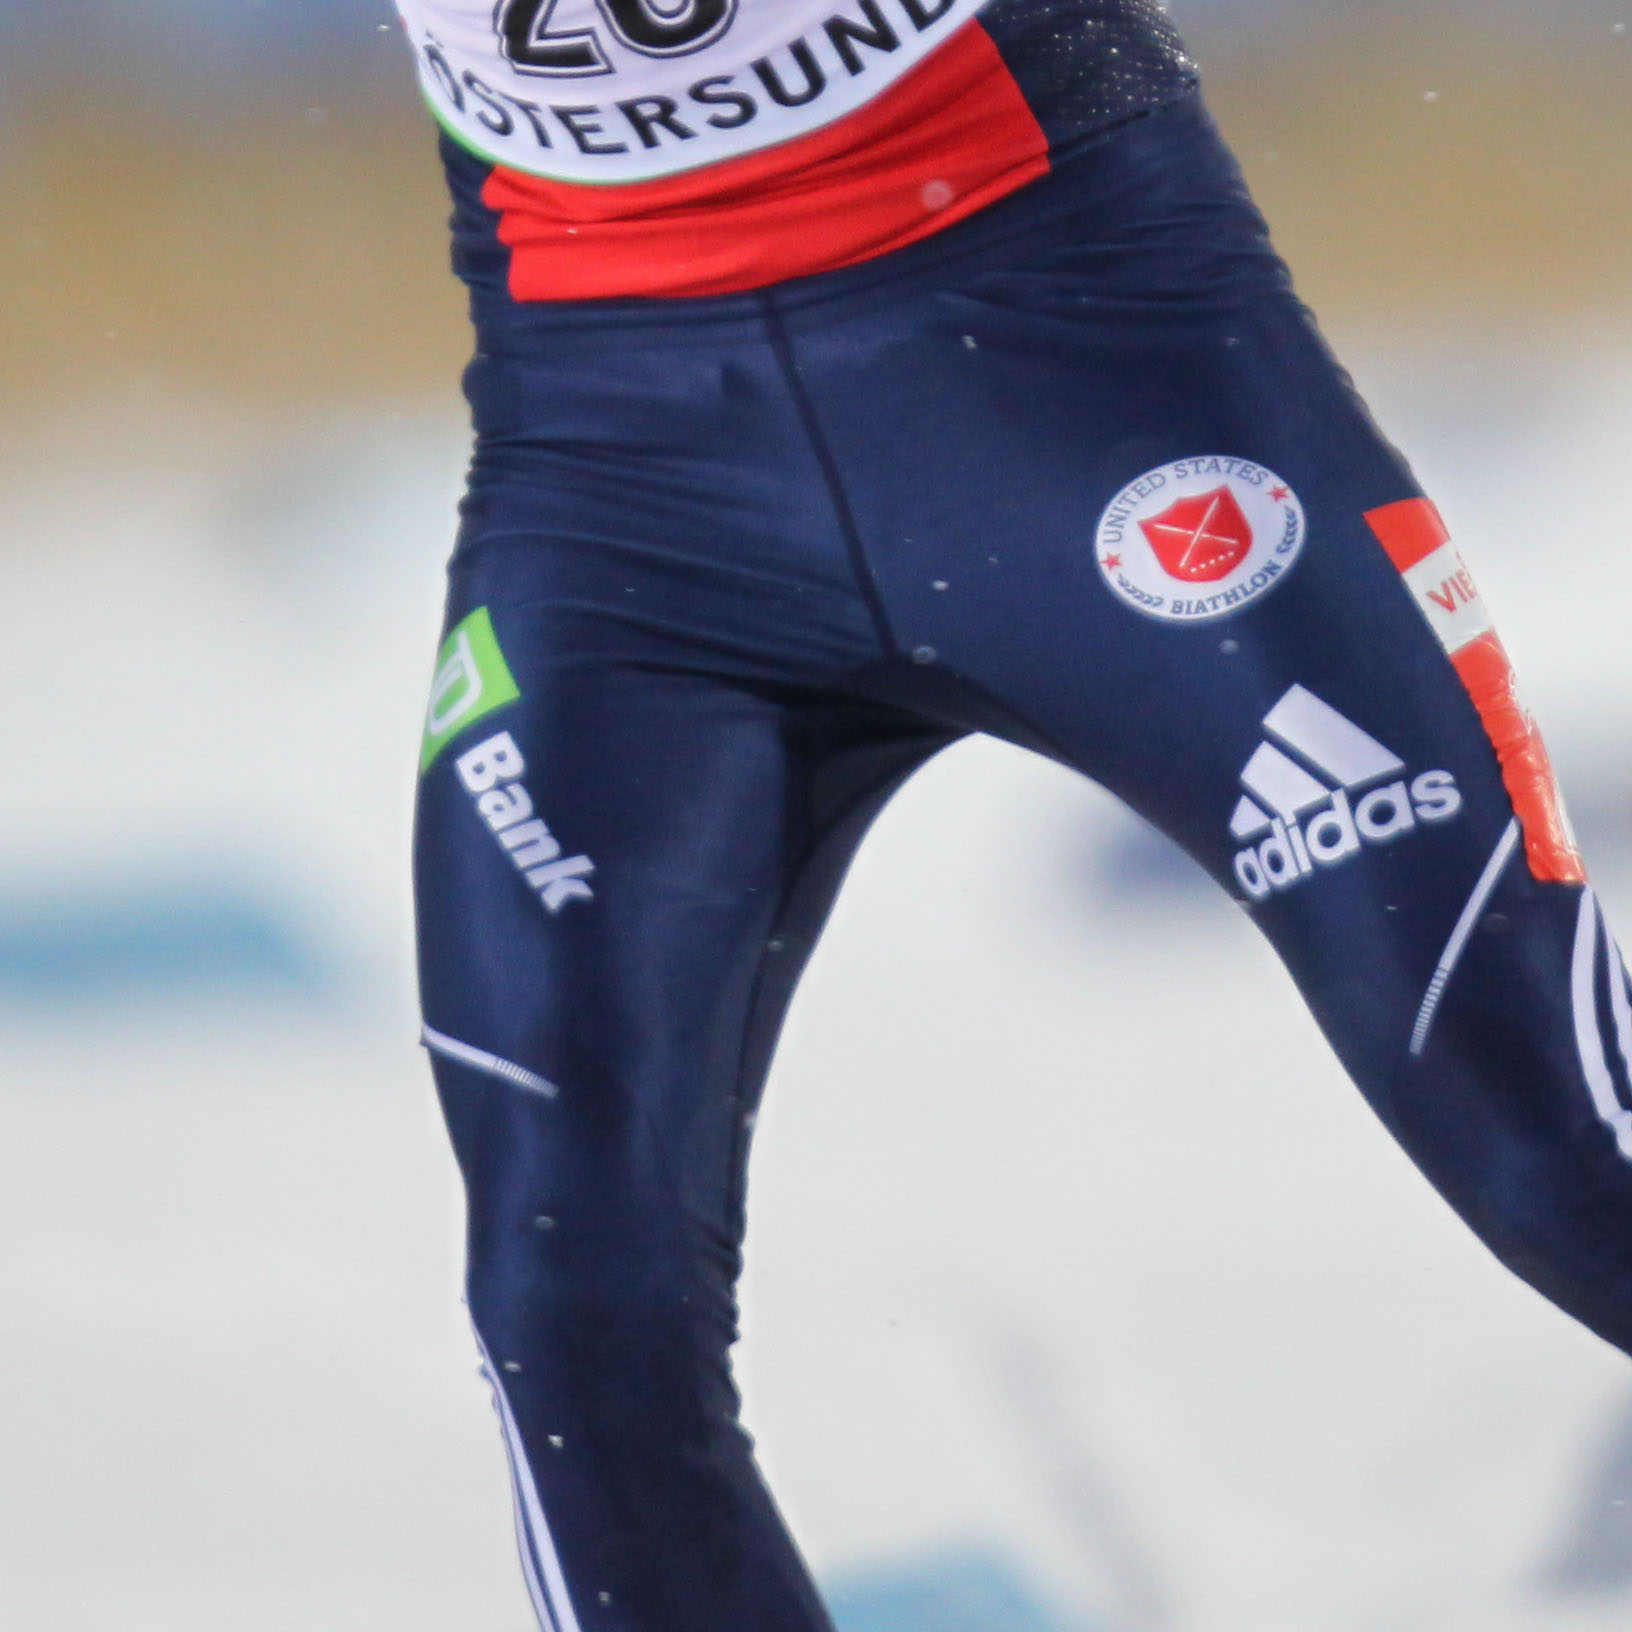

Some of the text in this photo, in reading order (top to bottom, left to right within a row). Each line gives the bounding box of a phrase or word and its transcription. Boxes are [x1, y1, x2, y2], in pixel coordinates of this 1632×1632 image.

[1104, 457, 1269, 544] UNITED STATES
[1170, 559, 1282, 615] BIATHLON
[455, 730, 596, 915] Bank
[1232, 770, 1463, 899] adidas
